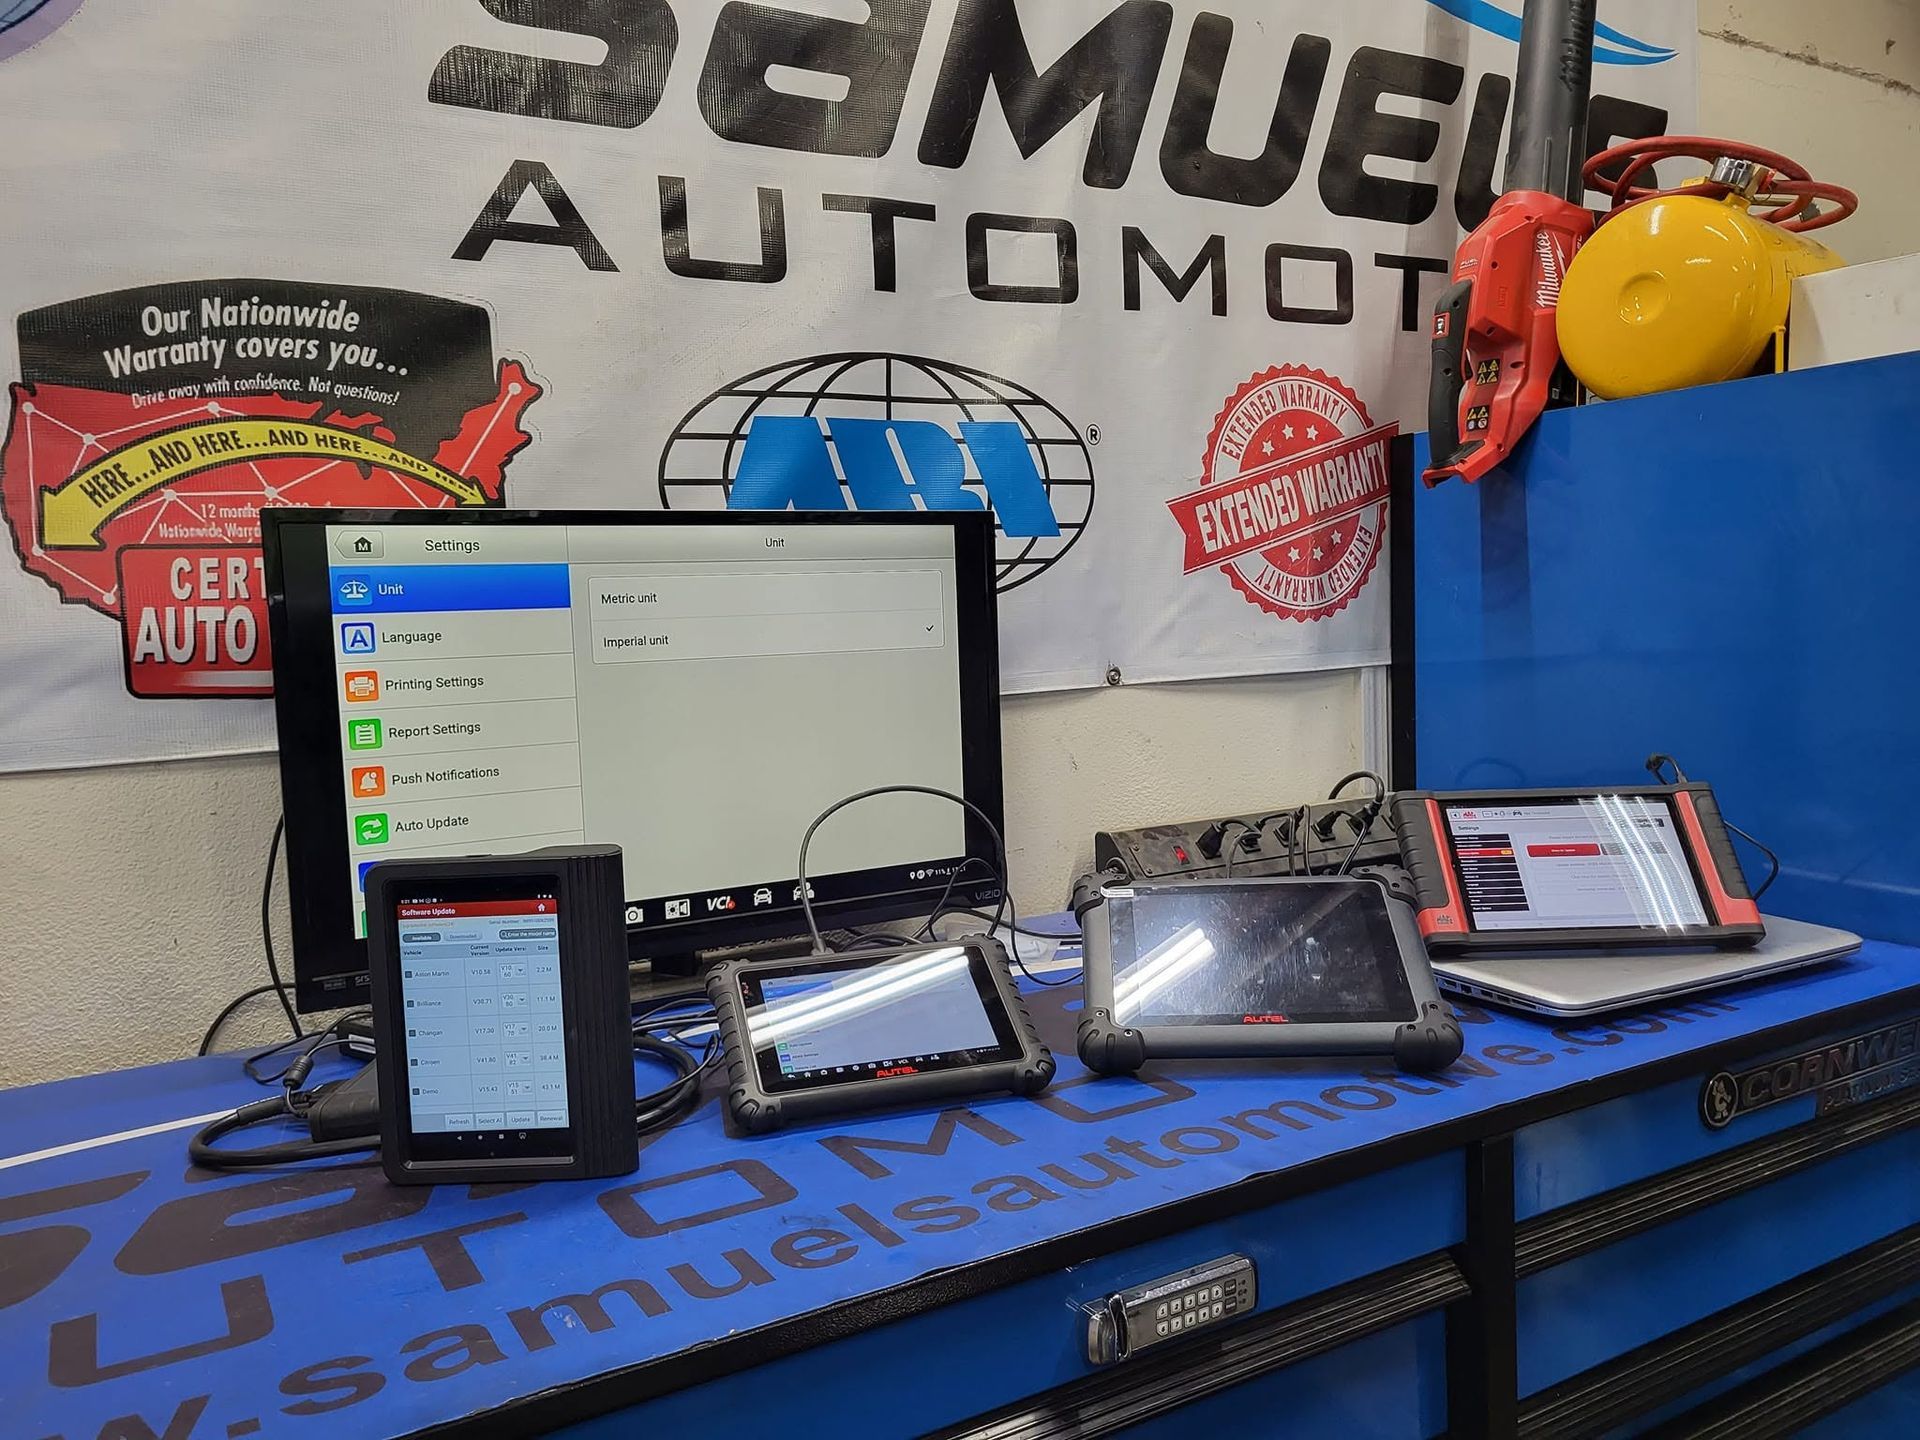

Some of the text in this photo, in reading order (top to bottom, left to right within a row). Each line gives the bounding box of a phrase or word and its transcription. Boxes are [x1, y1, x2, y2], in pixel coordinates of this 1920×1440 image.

[1536, 232, 1560, 308] Milwaukee
[142, 296, 360, 336] Our Nationwide
[103, 335, 408, 378] Warranty covers you...
[132, 389, 164, 410] Drive
[168, 383, 200, 403] away
[204, 375, 230, 394] with
[308, 376, 332, 393] Not
[334, 382, 400, 406] questions!
[1222, 384, 1348, 460] EXTENDED WARRANTY
[1195, 439, 1389, 554] EXTENDED WARRANTY
[201, 503, 216, 518] 12
[424, 539, 480, 553] Settings
[765, 538, 785, 548] Unit
[1255, 526, 1372, 602] EXTENDED WARRANTY
[378, 584, 404, 595] Unit
[601, 592, 657, 604] Metric unit
[134, 606, 256, 663] AUTO
[382, 631, 442, 646] Language
[604, 635, 669, 650] Imperial unit
[386, 675, 484, 693] Printing Settings
[388, 722, 481, 741] Report Settings
[392, 766, 500, 786] Push Notifications
[395, 815, 470, 832] Auto Update
[402, 908, 456, 917] Software Update
[1242, 1014, 1289, 1024] AUTEL
[876, 1066, 918, 1078] AUTEL
